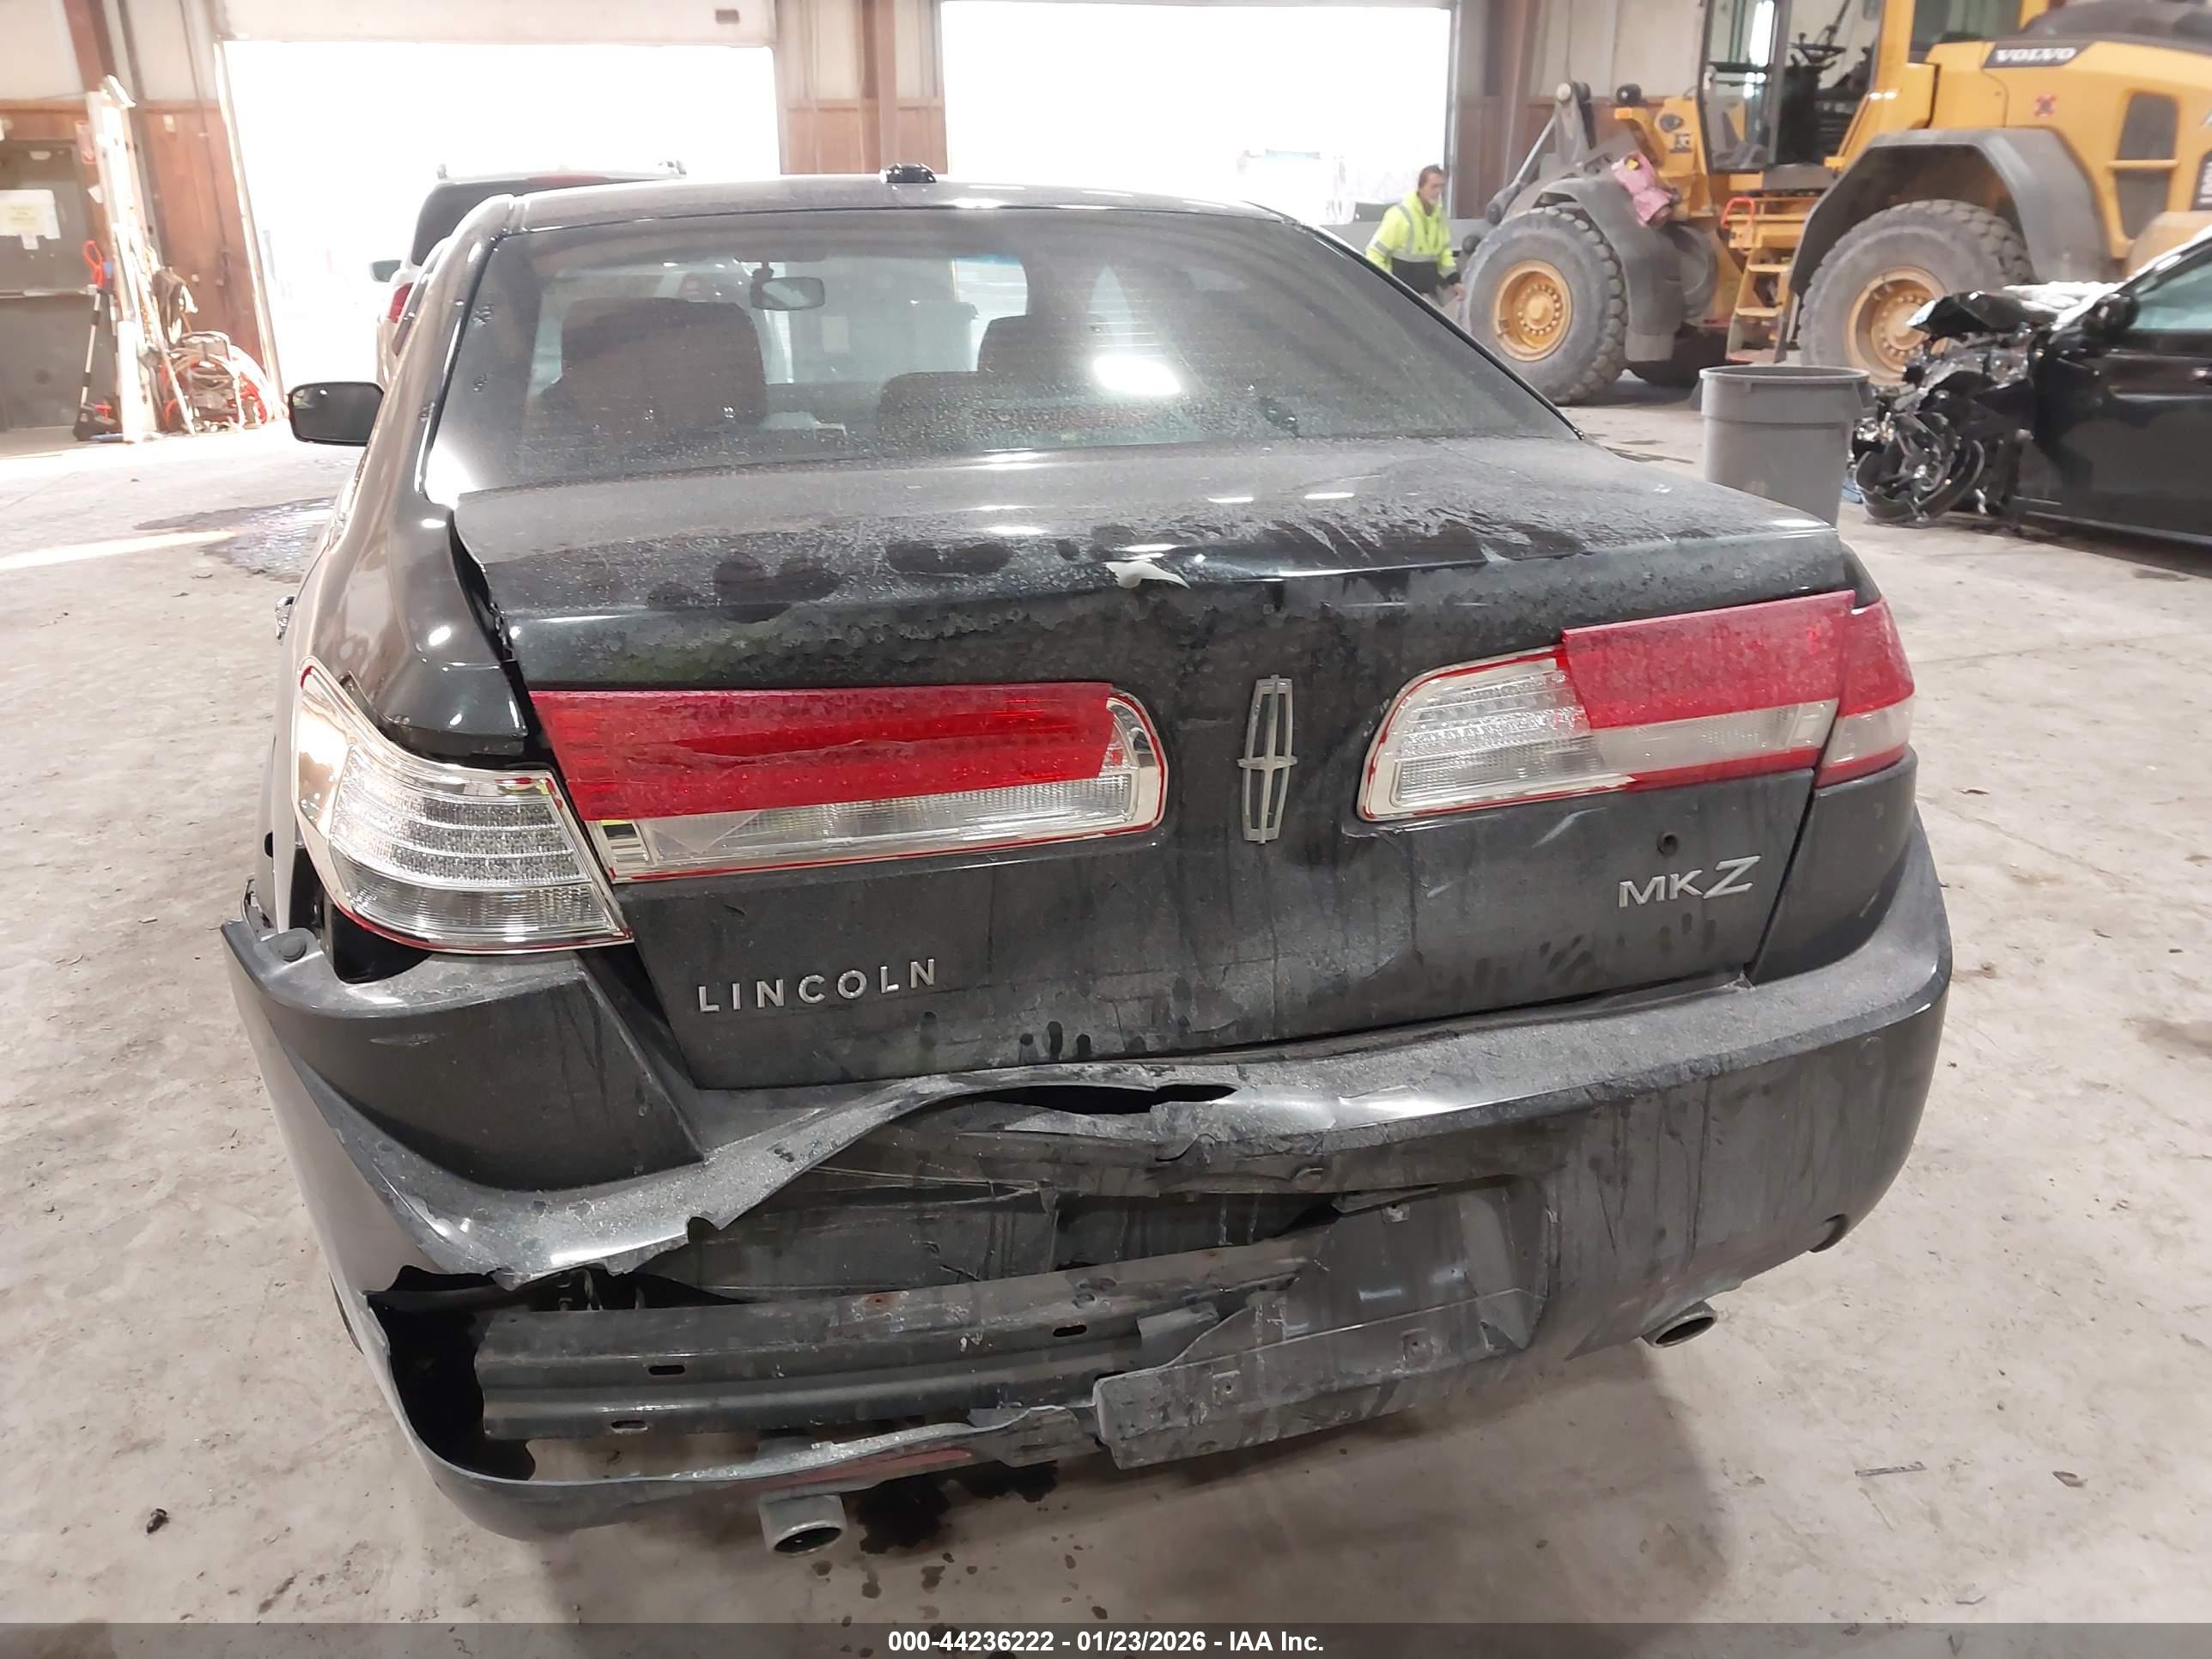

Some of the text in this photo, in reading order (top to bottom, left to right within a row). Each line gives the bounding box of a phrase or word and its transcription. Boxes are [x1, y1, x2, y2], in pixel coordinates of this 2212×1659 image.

[1996, 48, 2076, 63] VOLVO
[1618, 855, 1761, 908] MKZ
[697, 958, 935, 1012] LINCOLN
